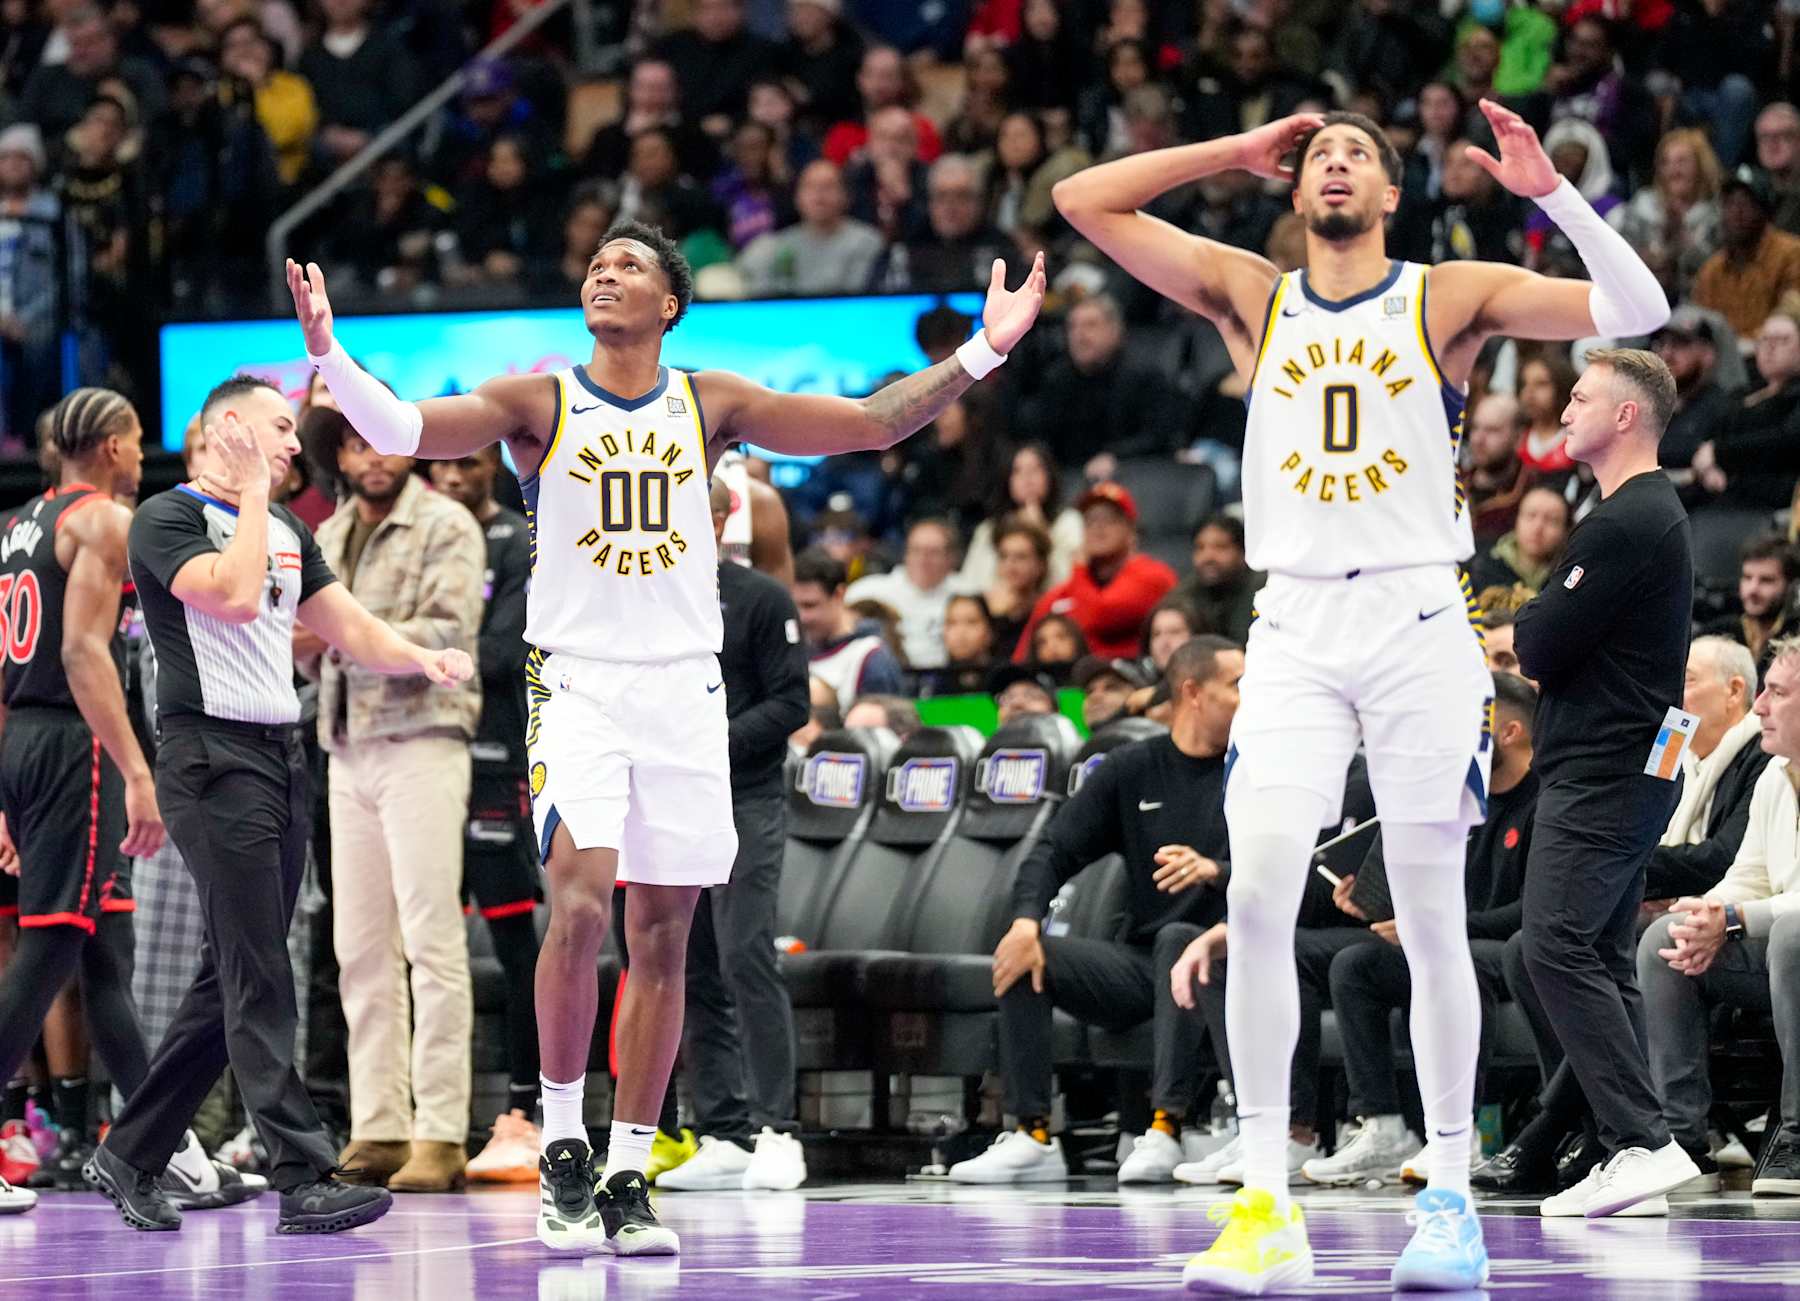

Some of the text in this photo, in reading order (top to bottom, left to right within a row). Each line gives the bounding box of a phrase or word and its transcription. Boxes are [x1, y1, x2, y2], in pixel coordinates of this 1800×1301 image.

[1273, 338, 1413, 399] INDIANA
[1323, 384, 1359, 453] 0
[568, 430, 694, 485] INDIANA
[1279, 448, 1408, 503] PACERS
[600, 470, 670, 533] 00
[576, 528, 687, 576] PACERS
